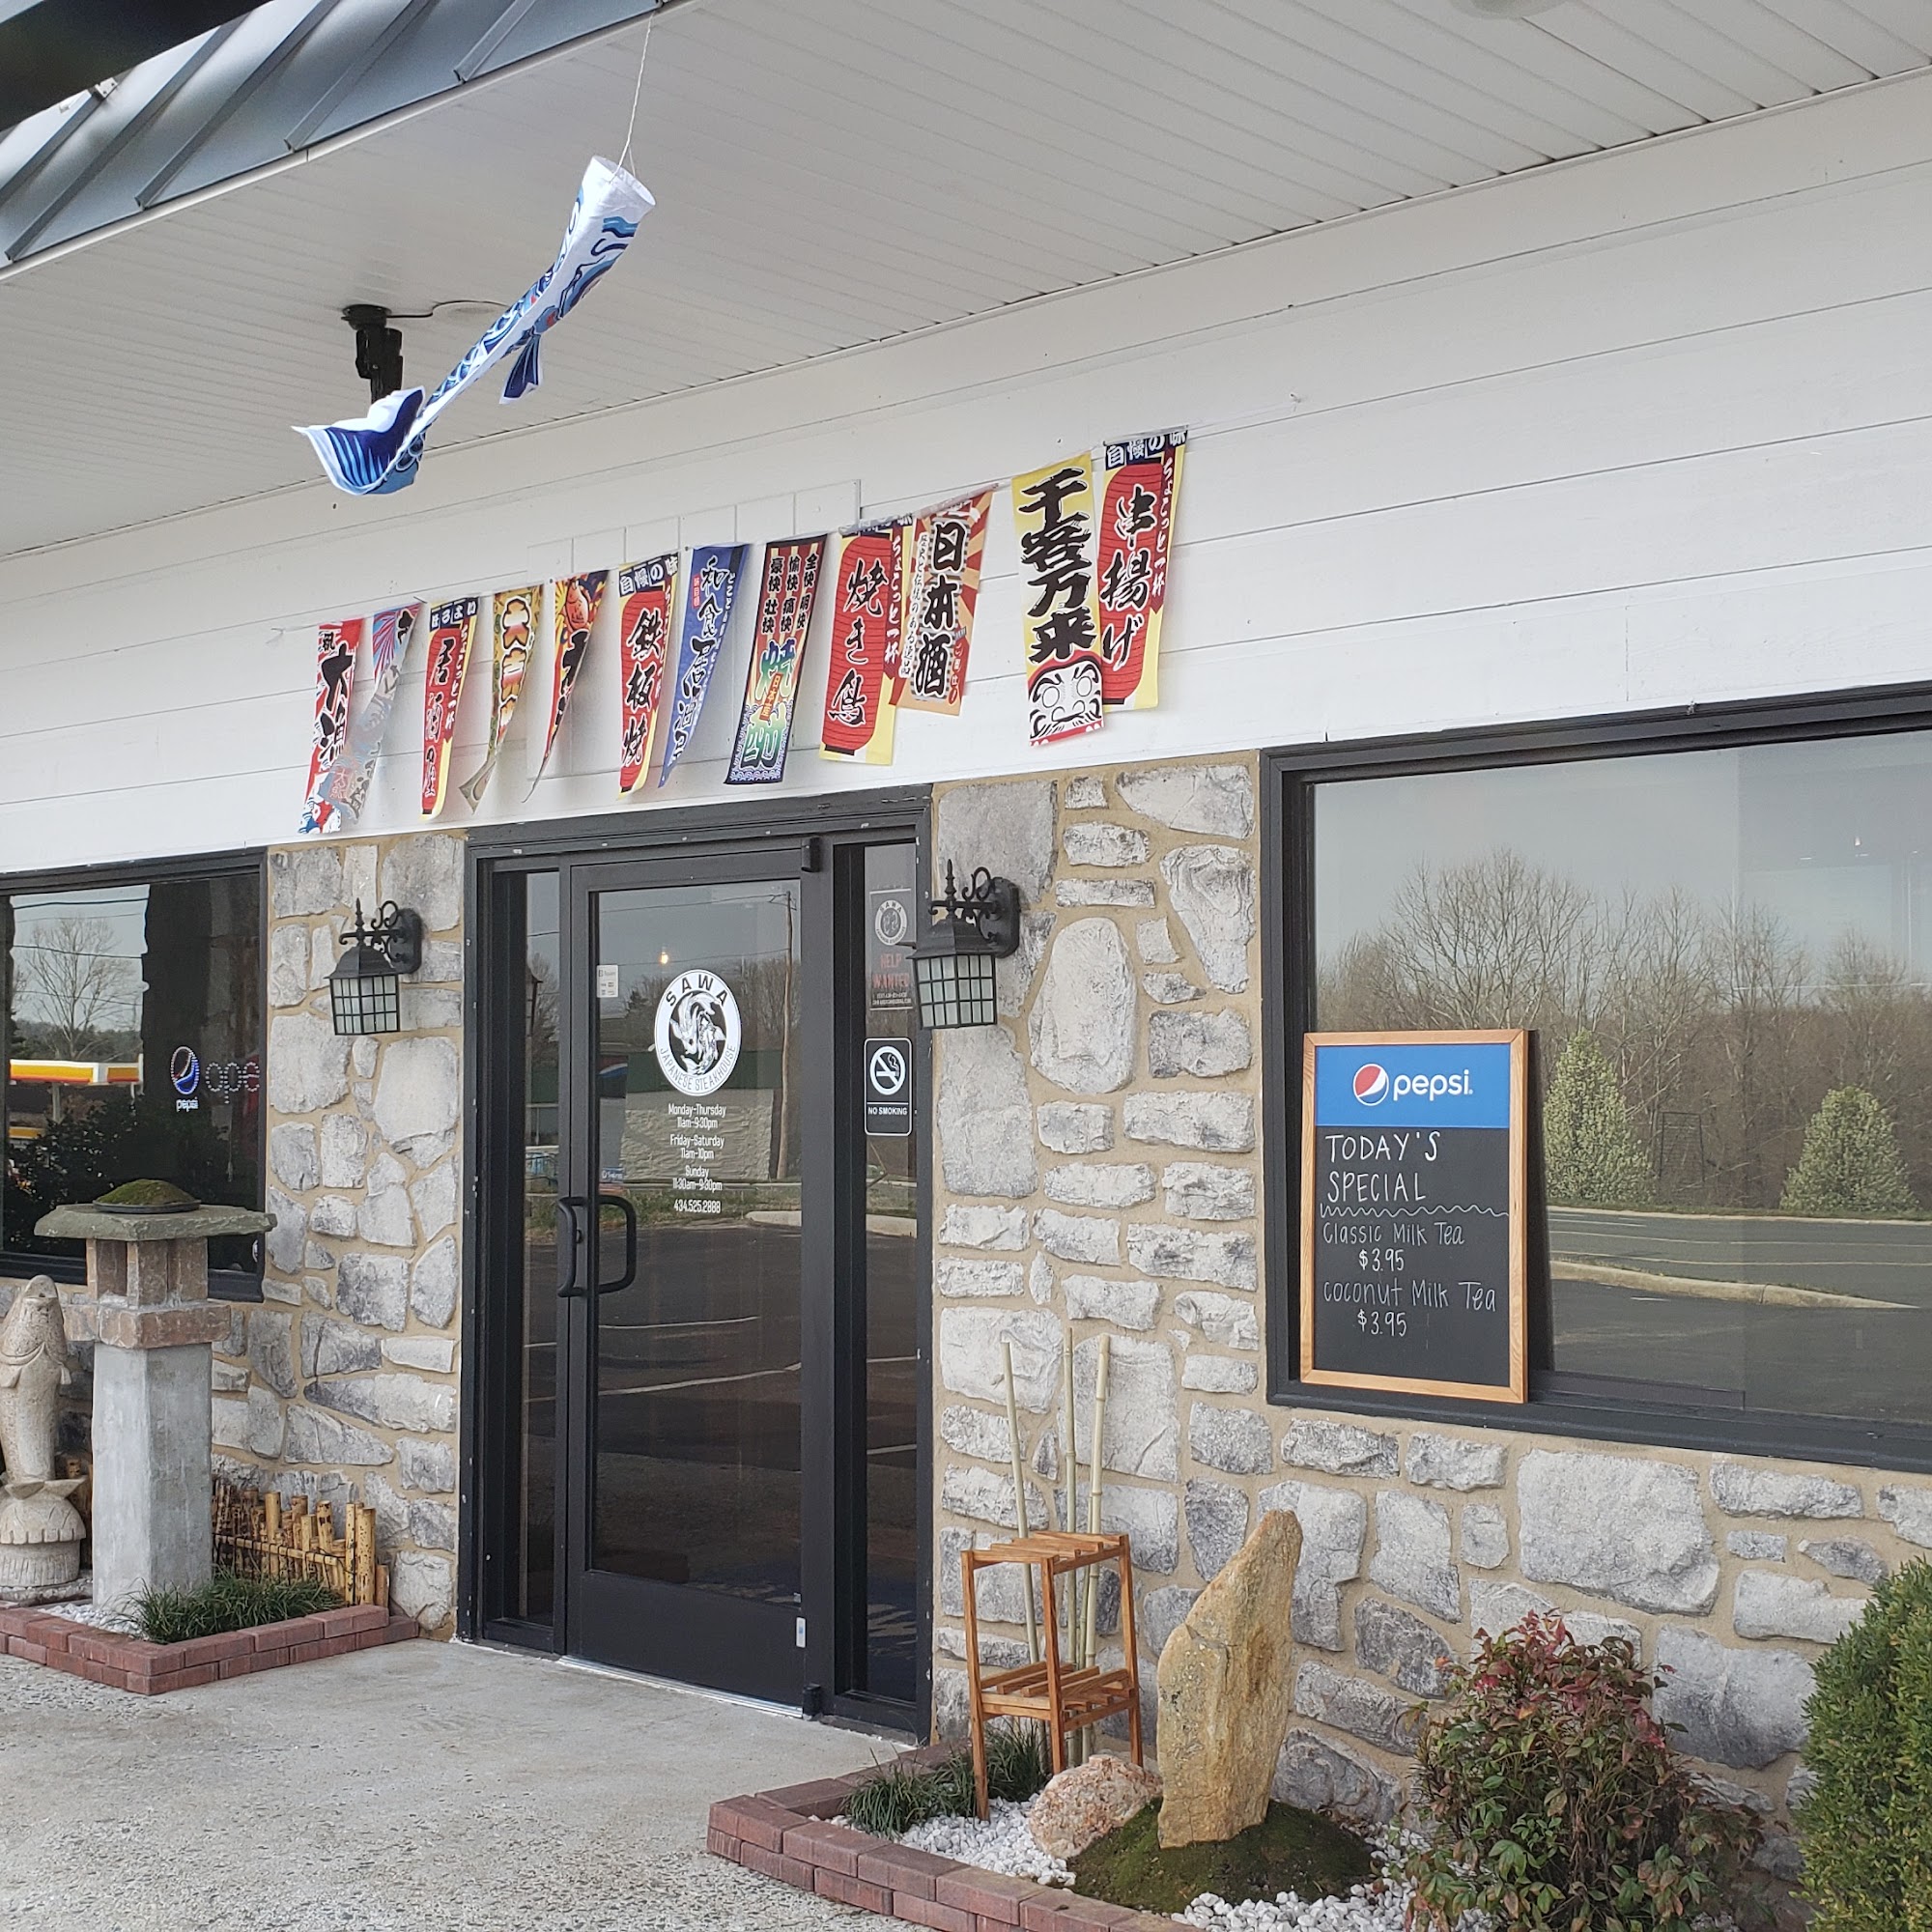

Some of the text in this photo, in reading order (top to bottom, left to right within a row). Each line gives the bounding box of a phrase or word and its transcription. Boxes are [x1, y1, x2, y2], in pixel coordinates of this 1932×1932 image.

[1099, 483, 1158, 672] 串揚げ
[431, 600, 477, 628] ほろよい
[913, 520, 968, 698] 日本酒
[828, 557, 889, 727] 焼き鳥
[621, 608, 663, 767] 鉄板焼
[666, 974, 728, 1007] SAWA
[205, 1062, 260, 1104] ope
[660, 1044, 736, 1092] JAPANESE STEAKHOUSE
[1393, 1069, 1471, 1101] pepsi
[176, 1095, 199, 1113] pepsi
[668, 1102, 727, 1118] Monday-Thursday
[867, 1106, 908, 1116] NO SMOKING
[669, 1133, 724, 1149] Friday-Saturday
[1325, 1130, 1440, 1163] TODAY'S
[685, 1164, 709, 1179] Sunday
[1327, 1171, 1427, 1204] SPECIAL
[1322, 1221, 1465, 1246] Classic Milk Tea
[1358, 1248, 1405, 1272] $3.95
[1412, 1278, 1449, 1309] Milk
[1459, 1281, 1496, 1312] Tea
[1357, 1308, 1407, 1337] $3.95
